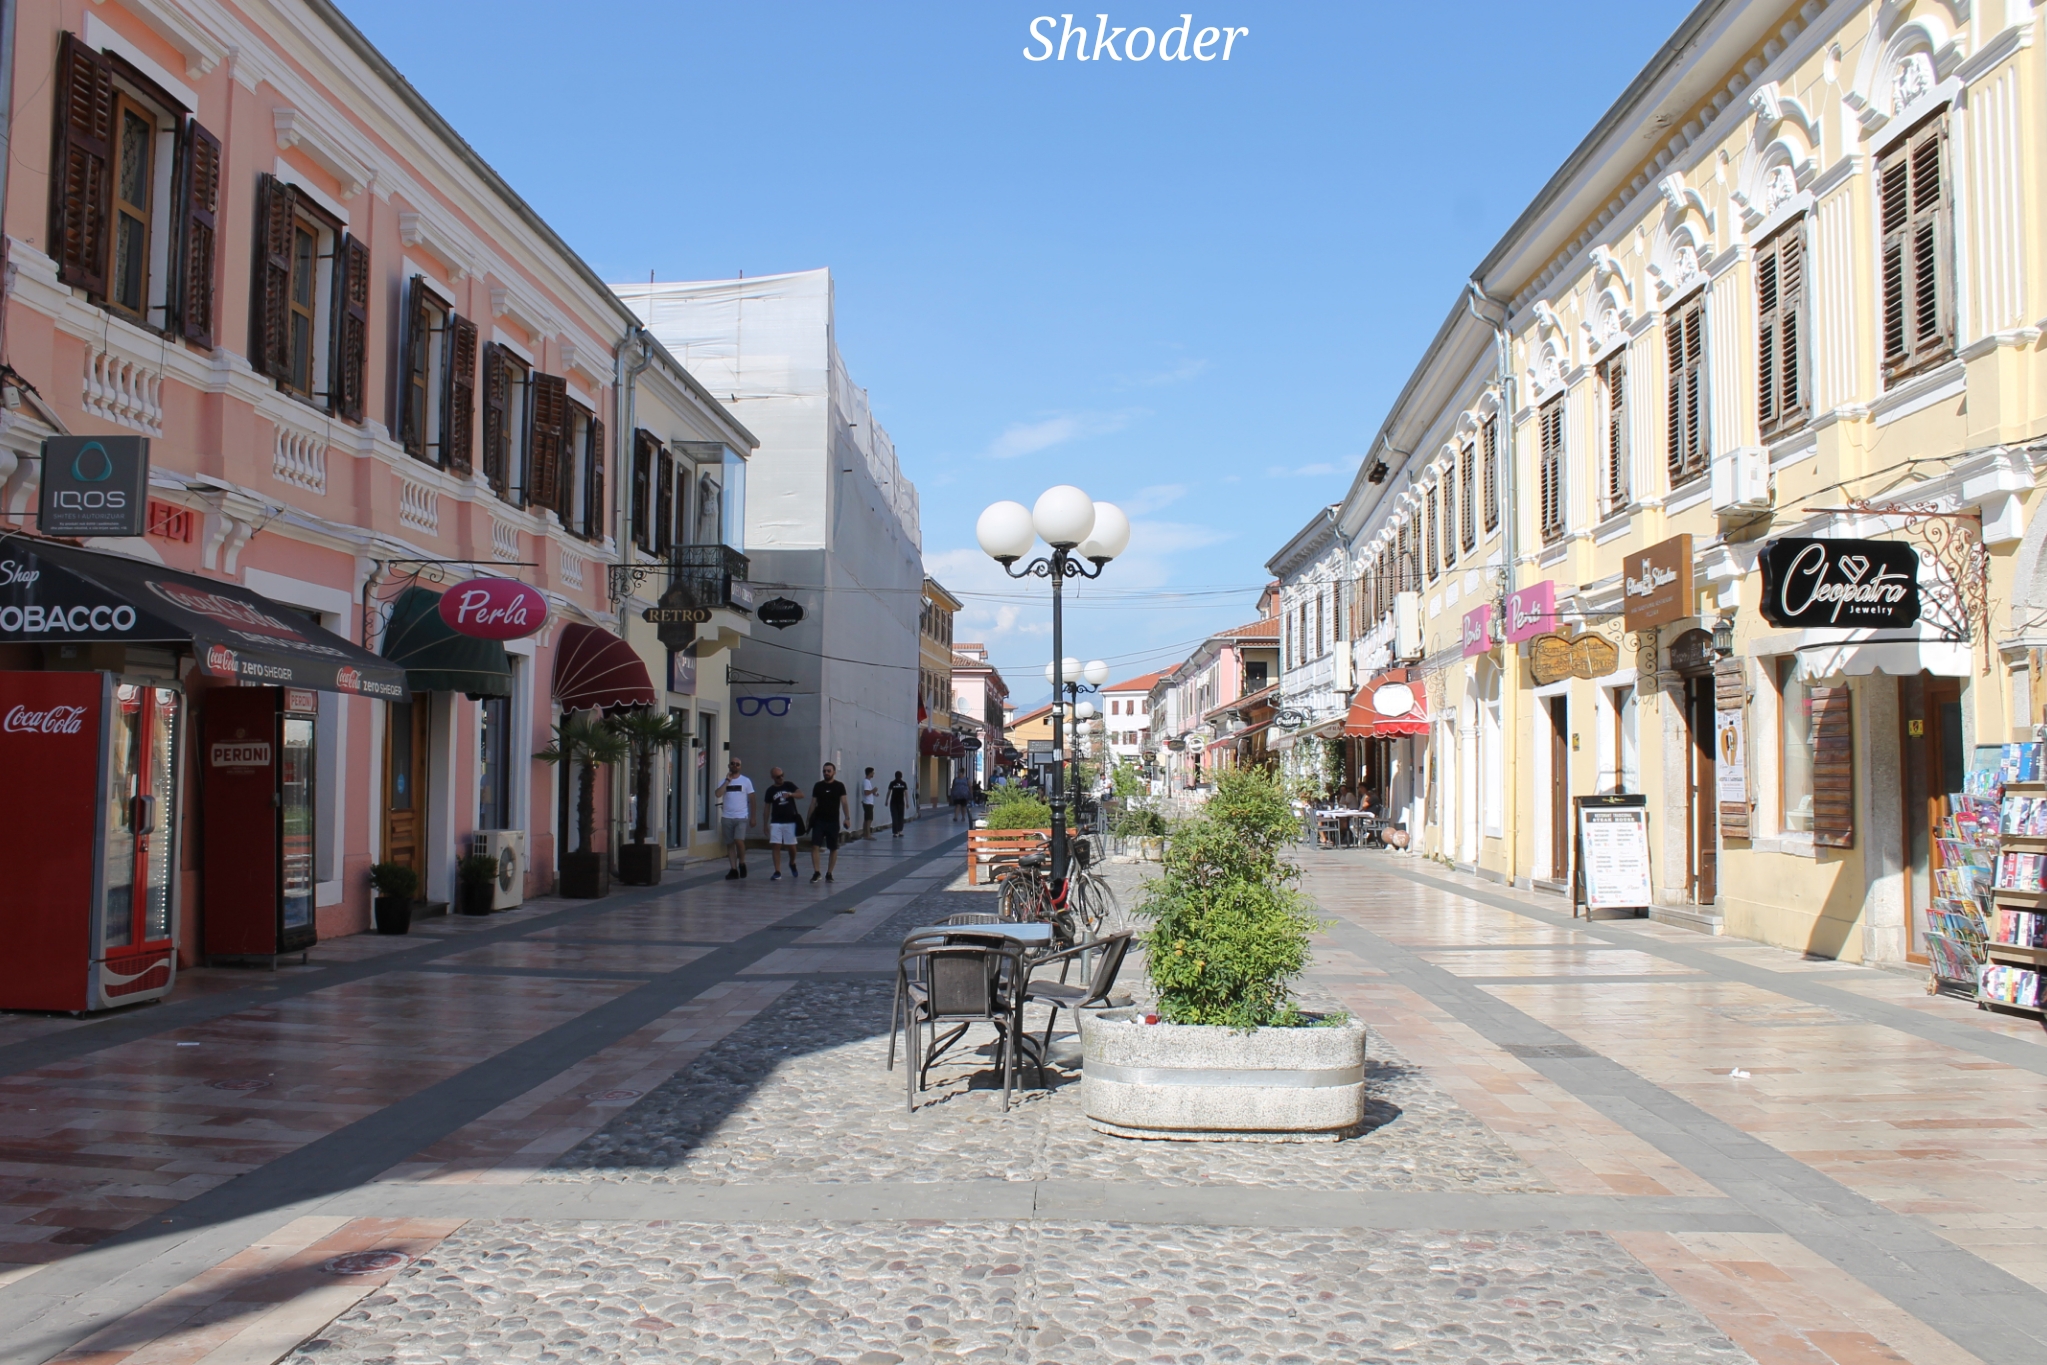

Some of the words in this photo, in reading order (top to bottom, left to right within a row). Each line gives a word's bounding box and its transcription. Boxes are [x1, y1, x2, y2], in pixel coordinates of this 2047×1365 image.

[53, 491, 126, 510] IQOS
[0, 560, 40, 589] Shop
[1782, 543, 1909, 623] Cleopatra
[457, 589, 528, 626] Perla
[648, 608, 706, 622] RETRO
[1510, 594, 1542, 634] Penti
[1849, 605, 1893, 616] Jewelry
[0, 605, 137, 632] OBACCO
[1463, 615, 1482, 650] Penti
[242, 661, 264, 676] zero
[264, 666, 292, 681] SHEQER
[363, 680, 379, 693] zero
[380, 684, 403, 697] SHEQER
[291, 695, 312, 706] PERONI
[213, 747, 268, 762] PERONI
